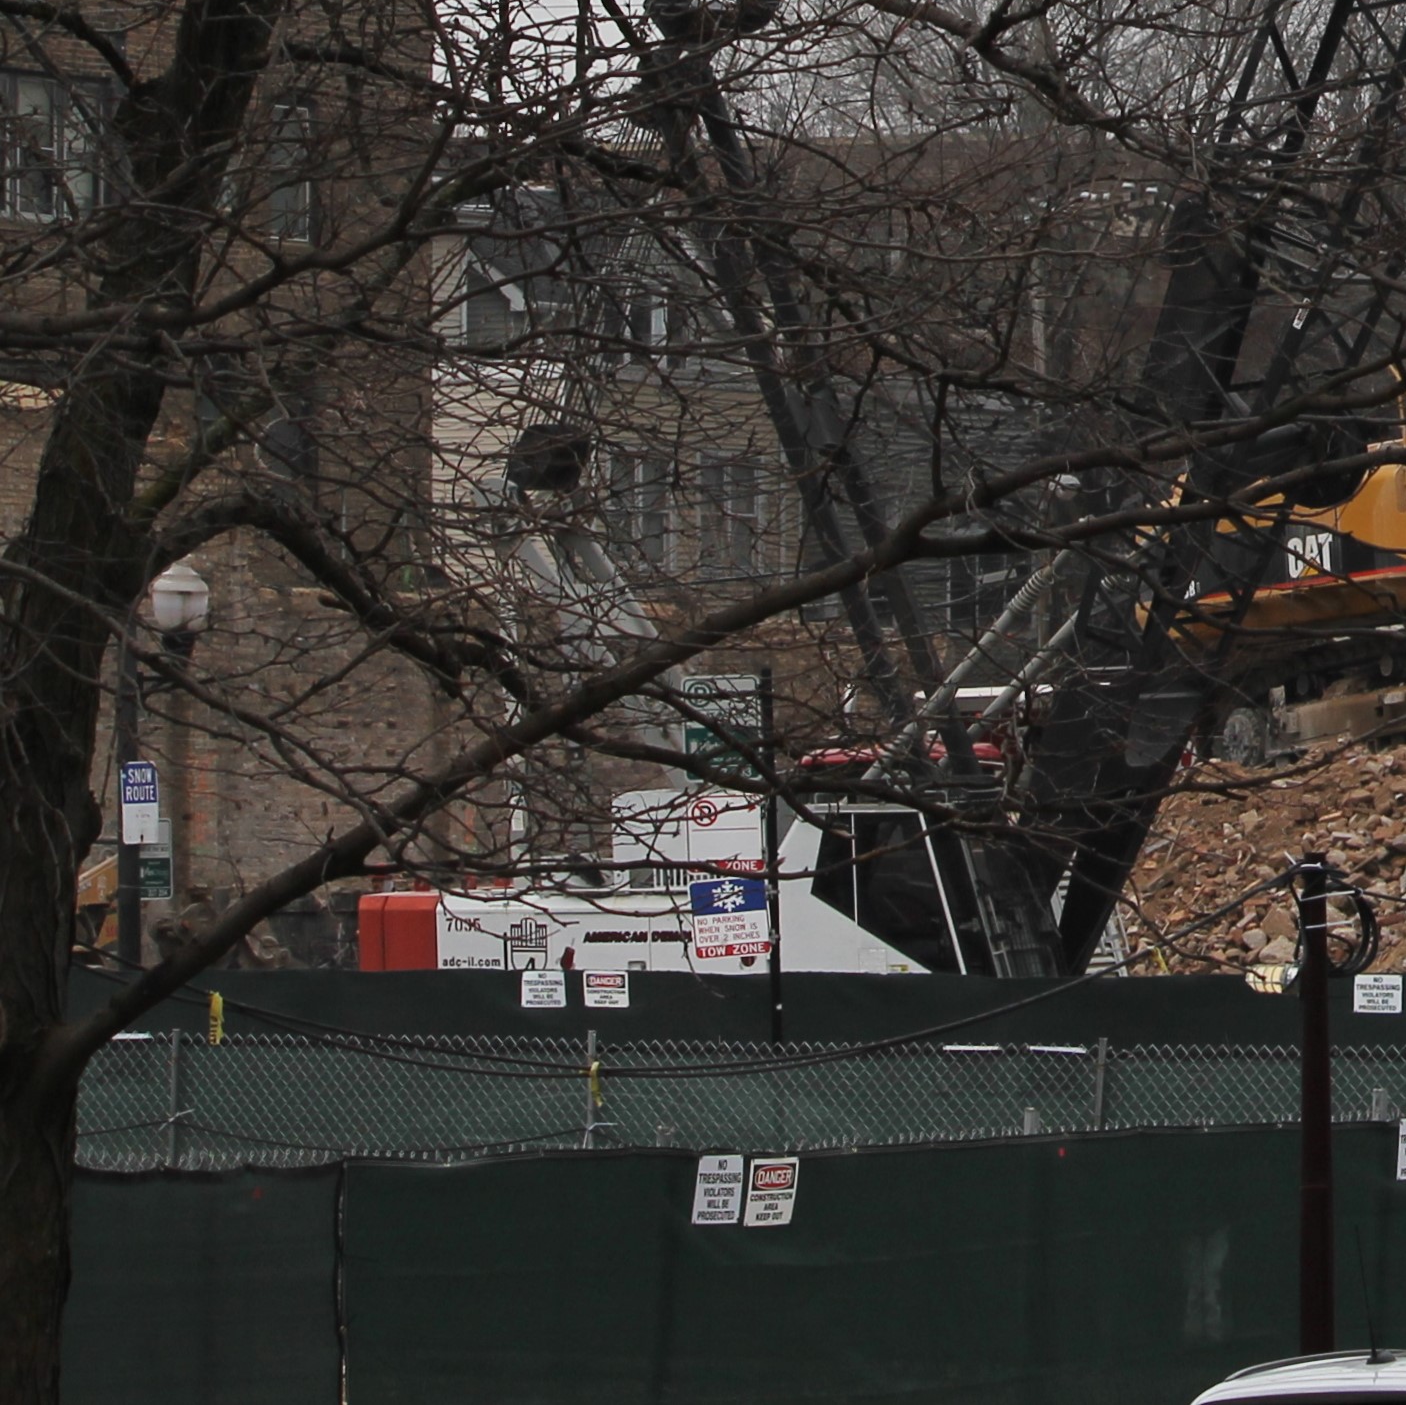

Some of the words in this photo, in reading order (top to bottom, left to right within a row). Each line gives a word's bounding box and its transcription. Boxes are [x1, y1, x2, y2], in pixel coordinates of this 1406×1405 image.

[1288, 532, 1333, 578] CAT
[127, 768, 153, 783] SNOW
[125, 785, 155, 801] ROUTE
[697, 917, 708, 925] NO
[712, 915, 745, 924] PARKING
[698, 925, 720, 934] WHEN
[724, 924, 746, 933] SNOW
[750, 922, 758, 930] IS
[699, 935, 719, 943] OVER
[733, 931, 761, 940] INCHES
[700, 946, 726, 957] TOW
[732, 943, 766, 954] ZONE
[442, 956, 501, 967] adc-il.com
[718, 1159, 728, 1170] NO
[699, 1173, 742, 1184] TRESPASSING
[757, 1170, 793, 1185] DANGER
